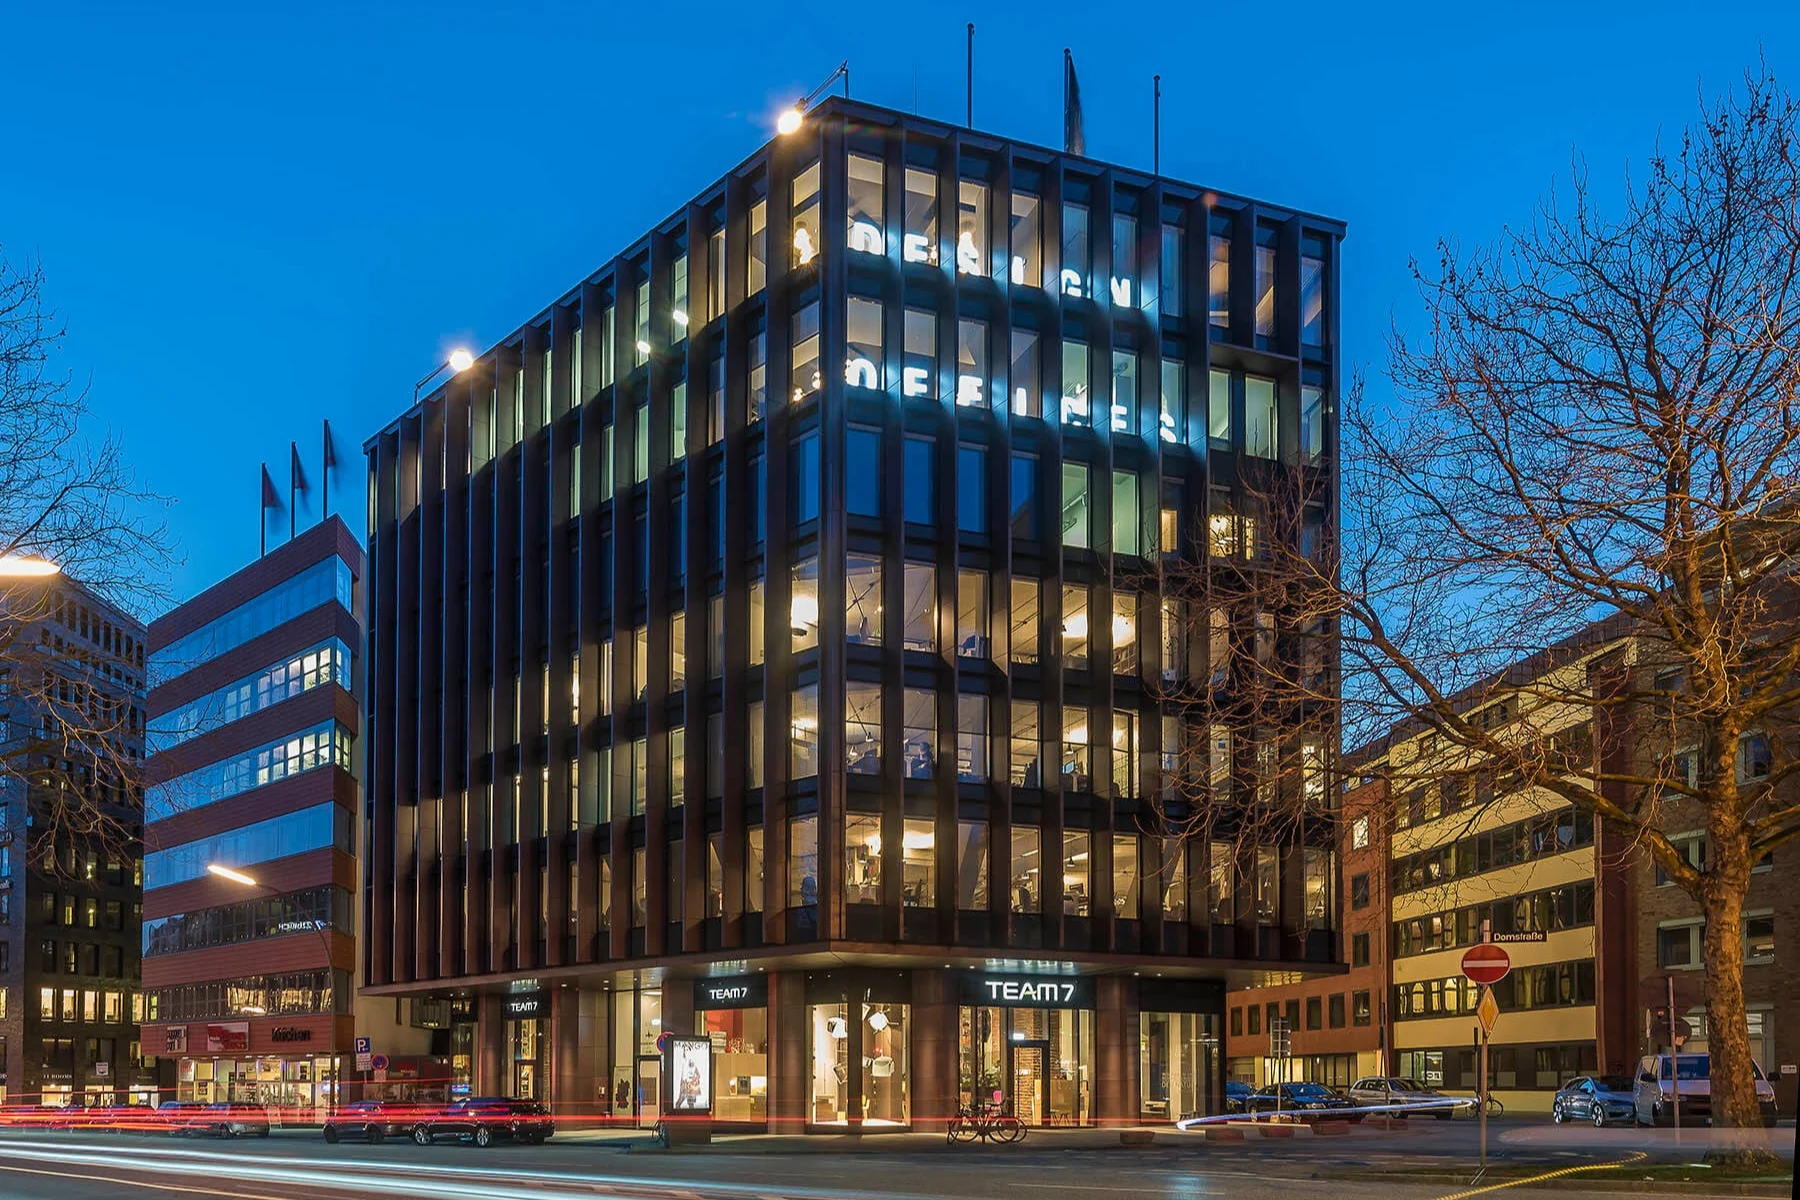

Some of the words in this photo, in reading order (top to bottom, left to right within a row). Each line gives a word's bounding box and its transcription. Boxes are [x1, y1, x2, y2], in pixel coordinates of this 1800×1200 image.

[1493, 931, 1543, 941] Domstraße
[357, 1039, 366, 1052] P
[674, 1041, 709, 1050] MANGO
